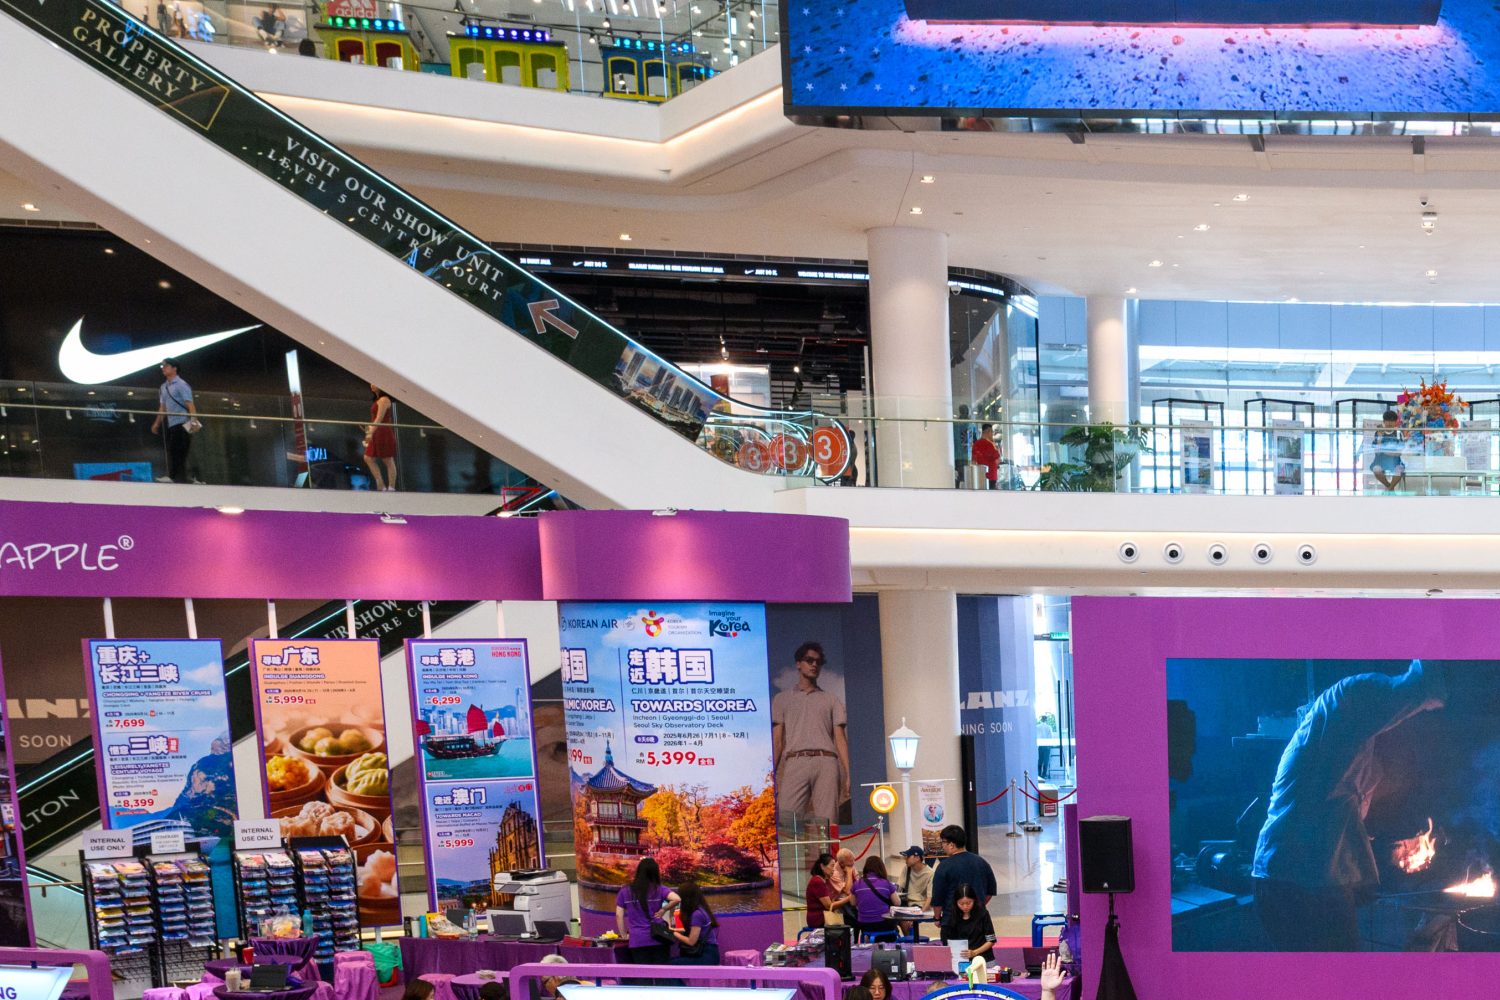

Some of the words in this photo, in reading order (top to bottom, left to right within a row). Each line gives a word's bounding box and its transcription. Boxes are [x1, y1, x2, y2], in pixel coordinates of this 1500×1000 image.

[80, 9, 205, 93] PROPERTY
[73, 25, 180, 98] GALLERY
[286, 136, 340, 178] VISIT
[345, 176, 386, 212] OUR
[393, 207, 448, 246] SHOW
[456, 245, 504, 282] UNIT
[267, 148, 327, 193] LEVEL
[337, 194, 347, 204] 5
[358, 205, 433, 259] CENTRE
[442, 258, 503, 301] COURT
[783, 439, 798, 464] 3
[816, 435, 833, 461] 3
[323, 625, 349, 640] UR
[354, 600, 398, 630] SHOW
[567, 619, 599, 629] KOREAN
[601, 619, 618, 629] AIR
[361, 616, 402, 639] NTRE
[708, 619, 751, 638] Korea
[273, 696, 304, 704] 5,999
[431, 696, 461, 705] 6,299
[581, 698, 615, 712] KOREA
[631, 699, 703, 713] TOWARDS
[704, 699, 757, 713] KOREA
[114, 719, 145, 728] 7,699
[662, 714, 705, 722] Gyeonggi-do
[651, 722, 664, 730] Sky
[664, 722, 706, 730] Observatory
[991, 721, 1013, 734] SOON
[19, 735, 72, 748] SOON
[647, 751, 696, 767] 5,399
[20, 788, 80, 831] LTON
[123, 799, 154, 808] 8,399
[90, 837, 126, 845] INTERNAL
[256, 834, 274, 842] ONLY
[445, 838, 474, 848] 5,999
